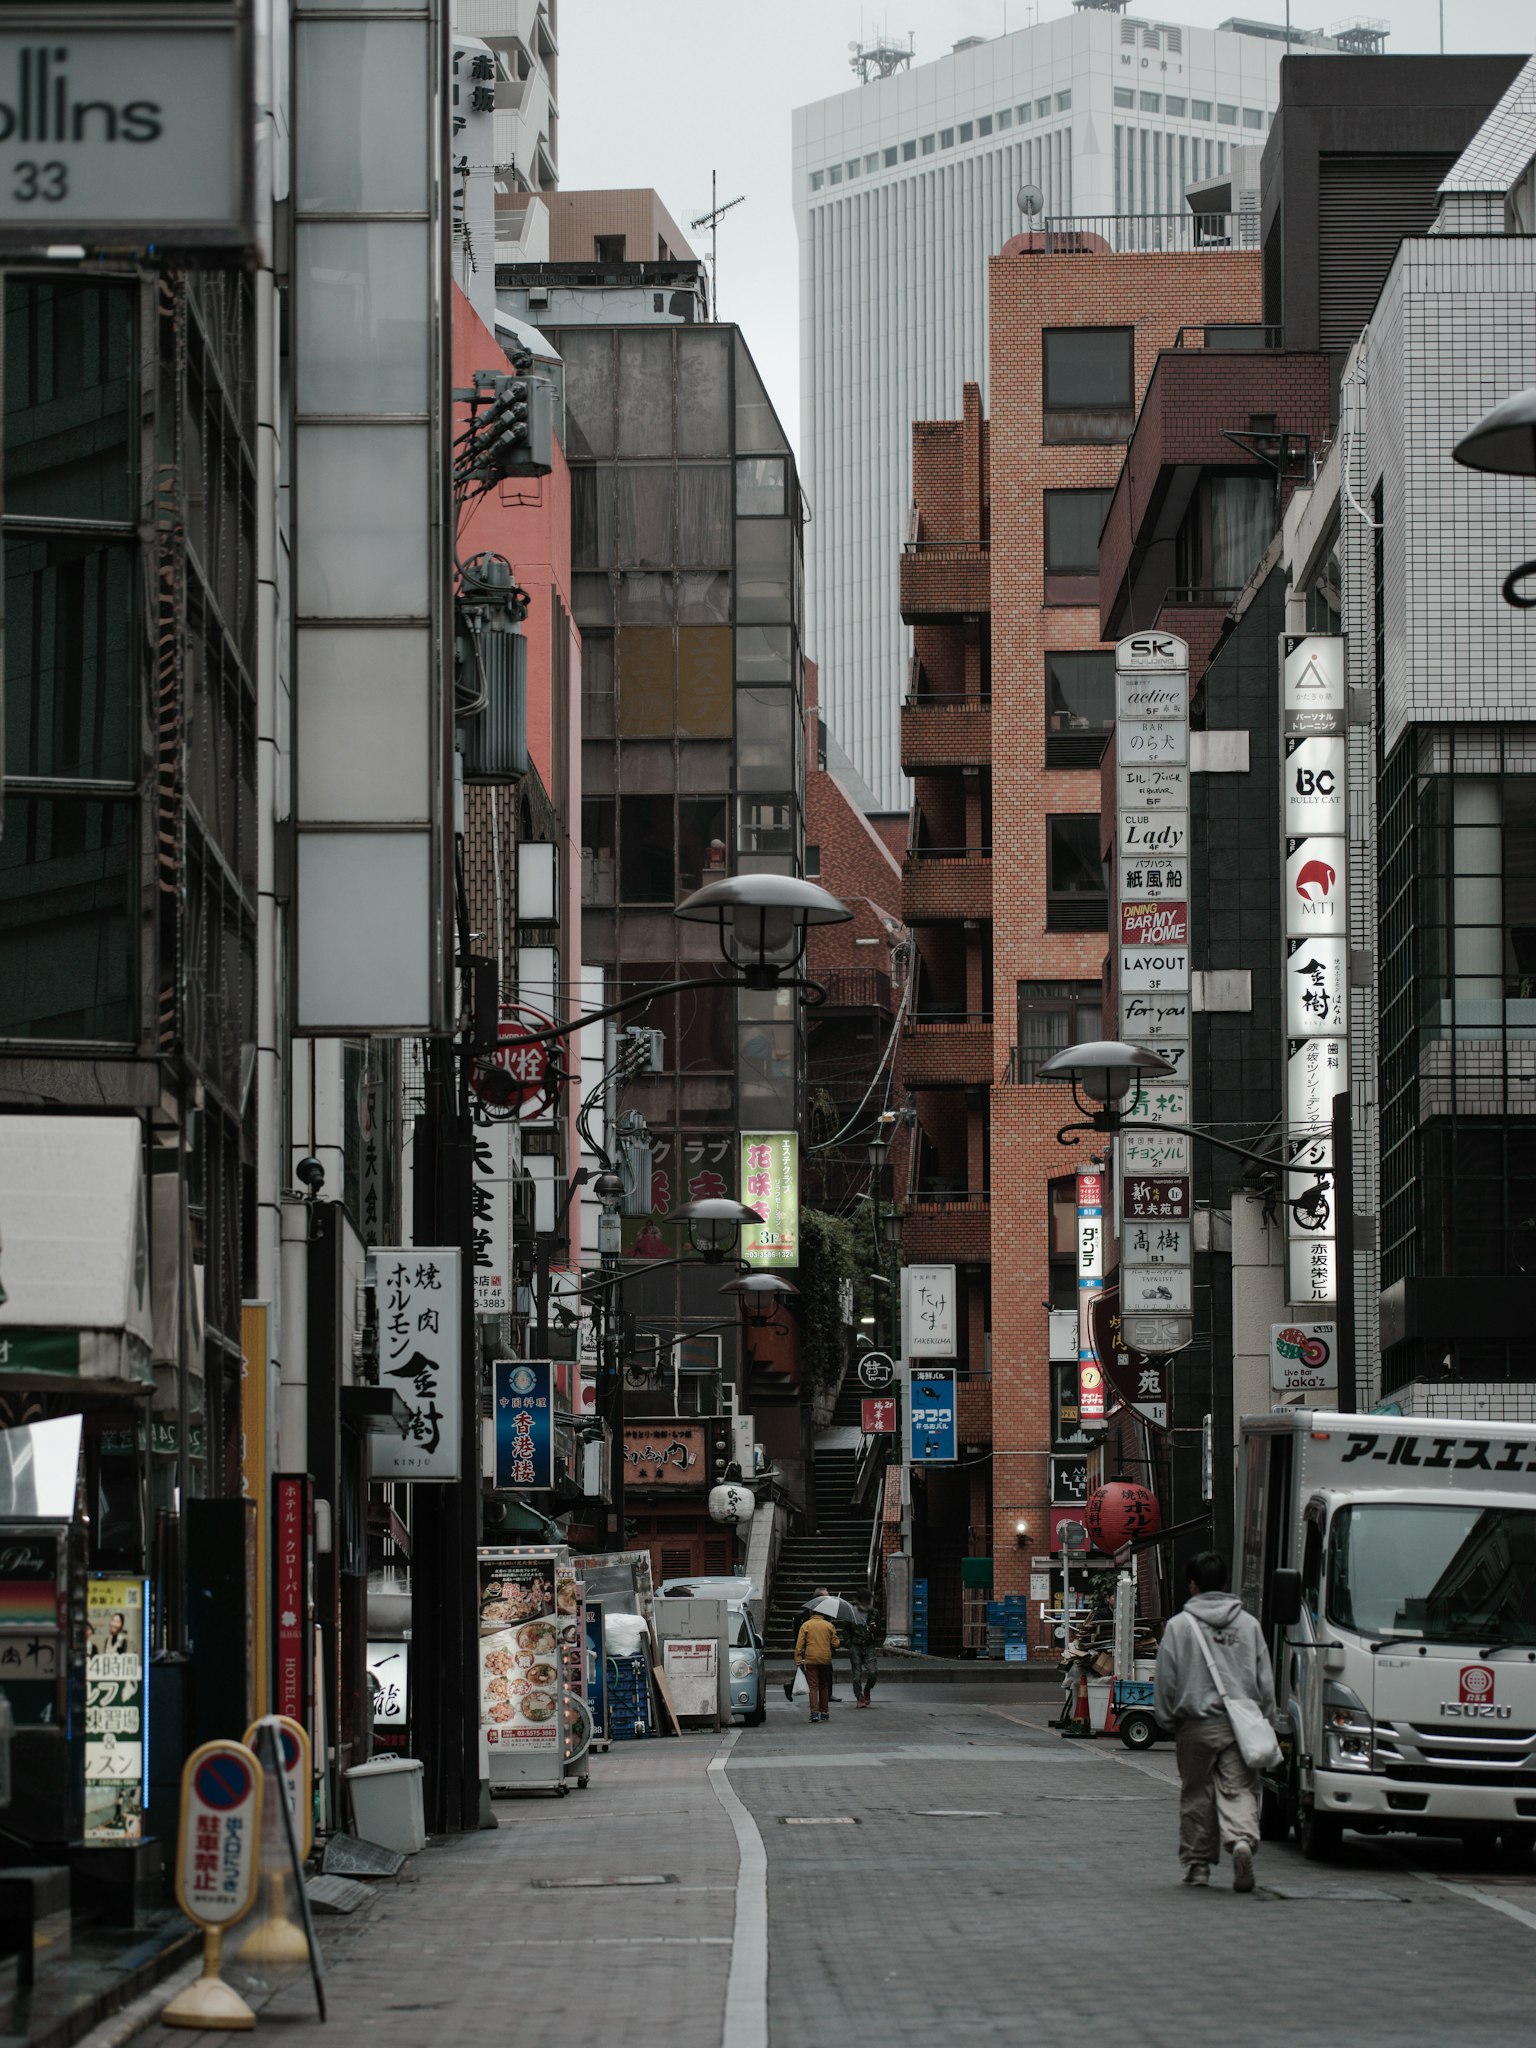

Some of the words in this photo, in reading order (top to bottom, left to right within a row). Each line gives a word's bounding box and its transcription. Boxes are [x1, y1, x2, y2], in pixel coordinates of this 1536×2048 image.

[1121, 55, 1182, 74] MORI
[472, 55, 494, 112] 赤坂
[13, 161, 68, 203] 33
[1131, 640, 1174, 657] SK
[1127, 689, 1180, 704] active
[1146, 707, 1160, 715] 5F
[1296, 713, 1334, 721] パーソナル
[1142, 723, 1163, 731] BAR
[1292, 722, 1337, 731] トレーニング
[1130, 734, 1175, 751] のら犬
[1290, 796, 1319, 804] BULLY
[1321, 796, 1341, 804] CAT
[1126, 816, 1149, 824] CLUB
[1126, 825, 1184, 848] Lady
[1126, 870, 1183, 888] 紙風船
[1124, 903, 1158, 918] DINING
[1301, 901, 1334, 917] MTJ
[1140, 923, 1186, 943] HOME
[1124, 957, 1185, 970] LAYOUT
[1149, 980, 1161, 988] 3F
[1125, 1000, 1154, 1020] for
[1156, 1006, 1186, 1022] you
[1332, 994, 1342, 1025] はなれ
[1149, 1026, 1162, 1034] 3F
[1327, 1042, 1339, 1069] 歯科
[473, 1047, 543, 1082] 火栓
[1129, 1090, 1184, 1116] 青松
[1152, 1112, 1162, 1121] 2F
[1127, 1146, 1185, 1160] チョンソル
[781, 1139, 793, 1194] エステクラブ
[1152, 1158, 1163, 1167] 2F
[1131, 1181, 1151, 1201] 新
[1170, 1190, 1180, 1199] 1F
[1133, 1203, 1172, 1215] 兄夫苑
[760, 1231, 779, 1244] 3F
[1311, 1243, 1328, 1300] 赤坂栄ビル
[413, 1262, 442, 1336] 焼肉
[491, 1289, 502, 1297] 4F
[386, 1263, 412, 1360] ホルモン
[920, 1311, 937, 1331] くま
[1135, 1320, 1181, 1338] SK
[913, 1337, 952, 1345] TAKEKUMA
[916, 1372, 945, 1380] 海鮮バル
[1285, 1376, 1325, 1388] Jaka'z
[499, 1396, 547, 1408] 中国料理
[884, 1401, 893, 1409] 2F
[1152, 1407, 1165, 1418] 1F
[511, 1410, 536, 1483] 香港楼
[393, 1457, 431, 1467] KINJU
[639, 1468, 664, 1478] 本店
[1121, 1488, 1149, 1501] 焼肉
[284, 1485, 297, 1606] ホテル・クローバー
[1378, 1660, 1411, 1668] ELF
[284, 1658, 296, 1702] HOTEL
[1465, 1693, 1488, 1702] RSS
[1440, 1700, 1512, 1719] ISUZU
[193, 1815, 221, 1891] 駐車禁止
[224, 1816, 243, 1893] 出入口につき
